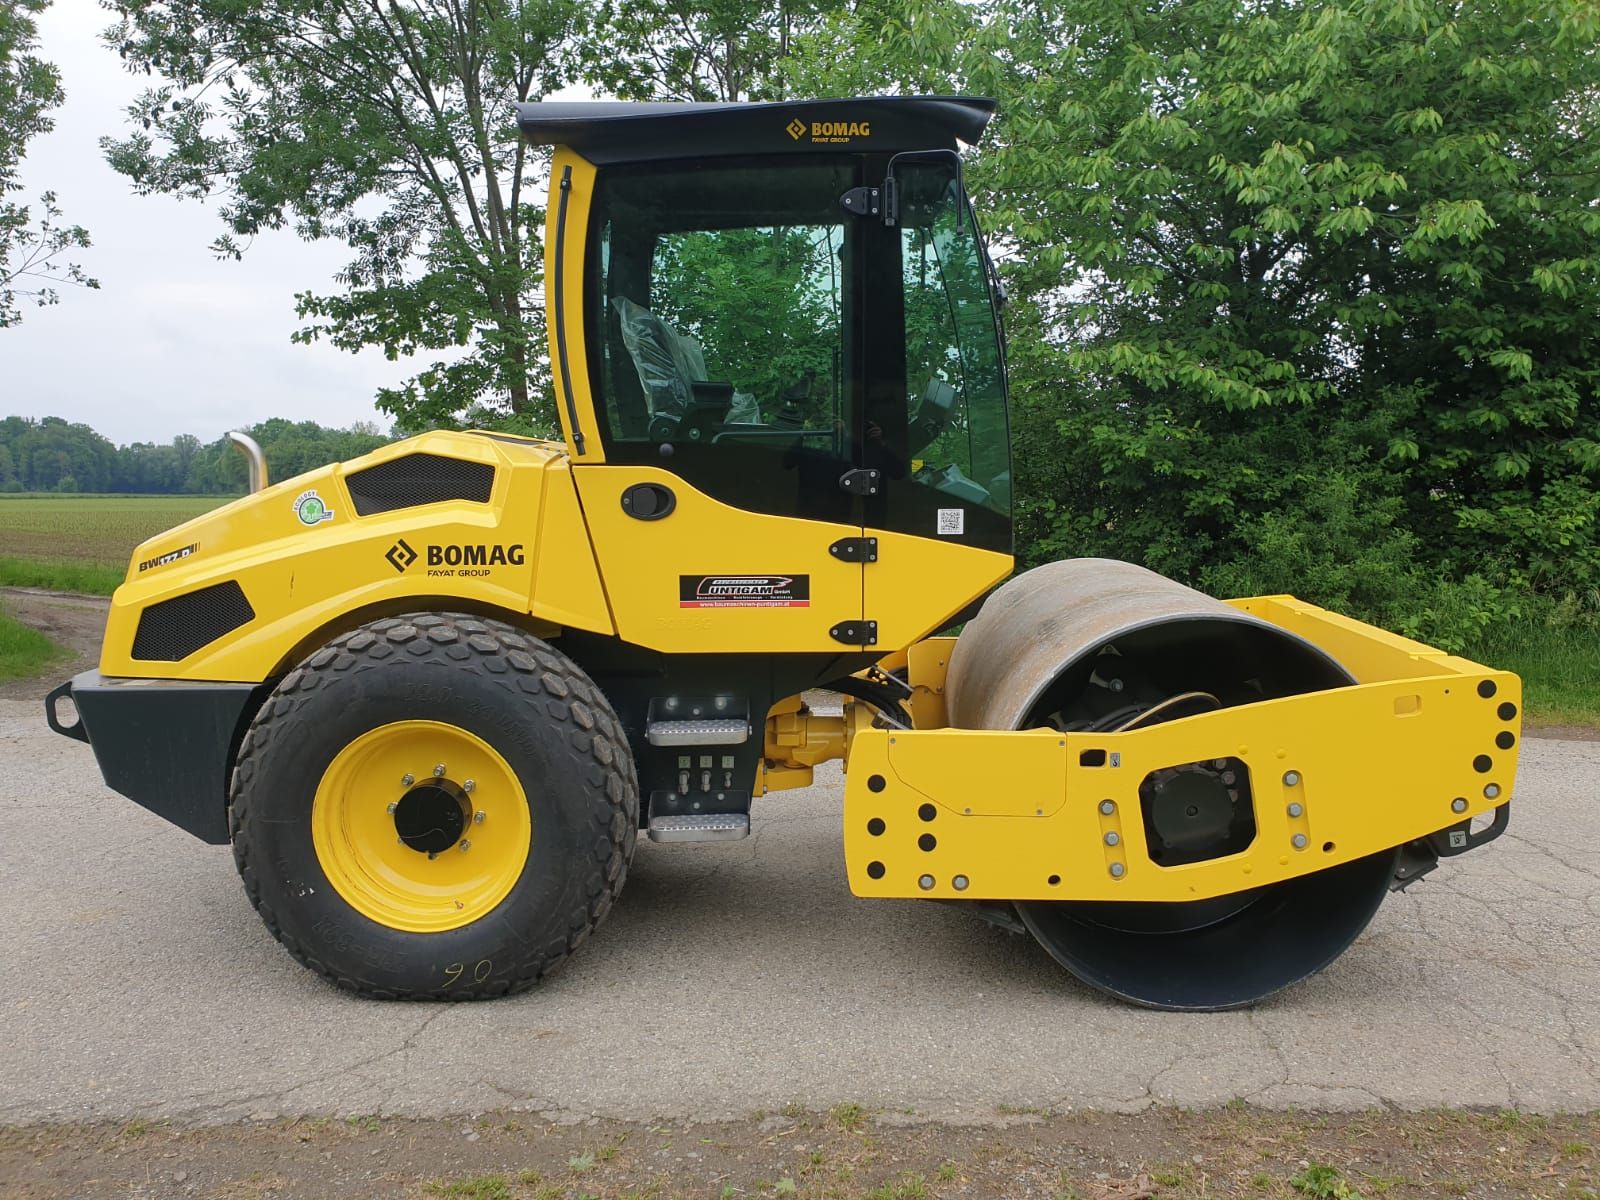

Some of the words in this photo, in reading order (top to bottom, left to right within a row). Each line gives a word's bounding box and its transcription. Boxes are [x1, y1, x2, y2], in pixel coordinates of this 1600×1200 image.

[811, 122, 870, 136] BOMAG
[293, 491, 316, 511] ECOLOGY
[427, 544, 525, 566] BOMAG
[427, 569, 455, 577] FAYAT
[458, 569, 491, 577] GROUP
